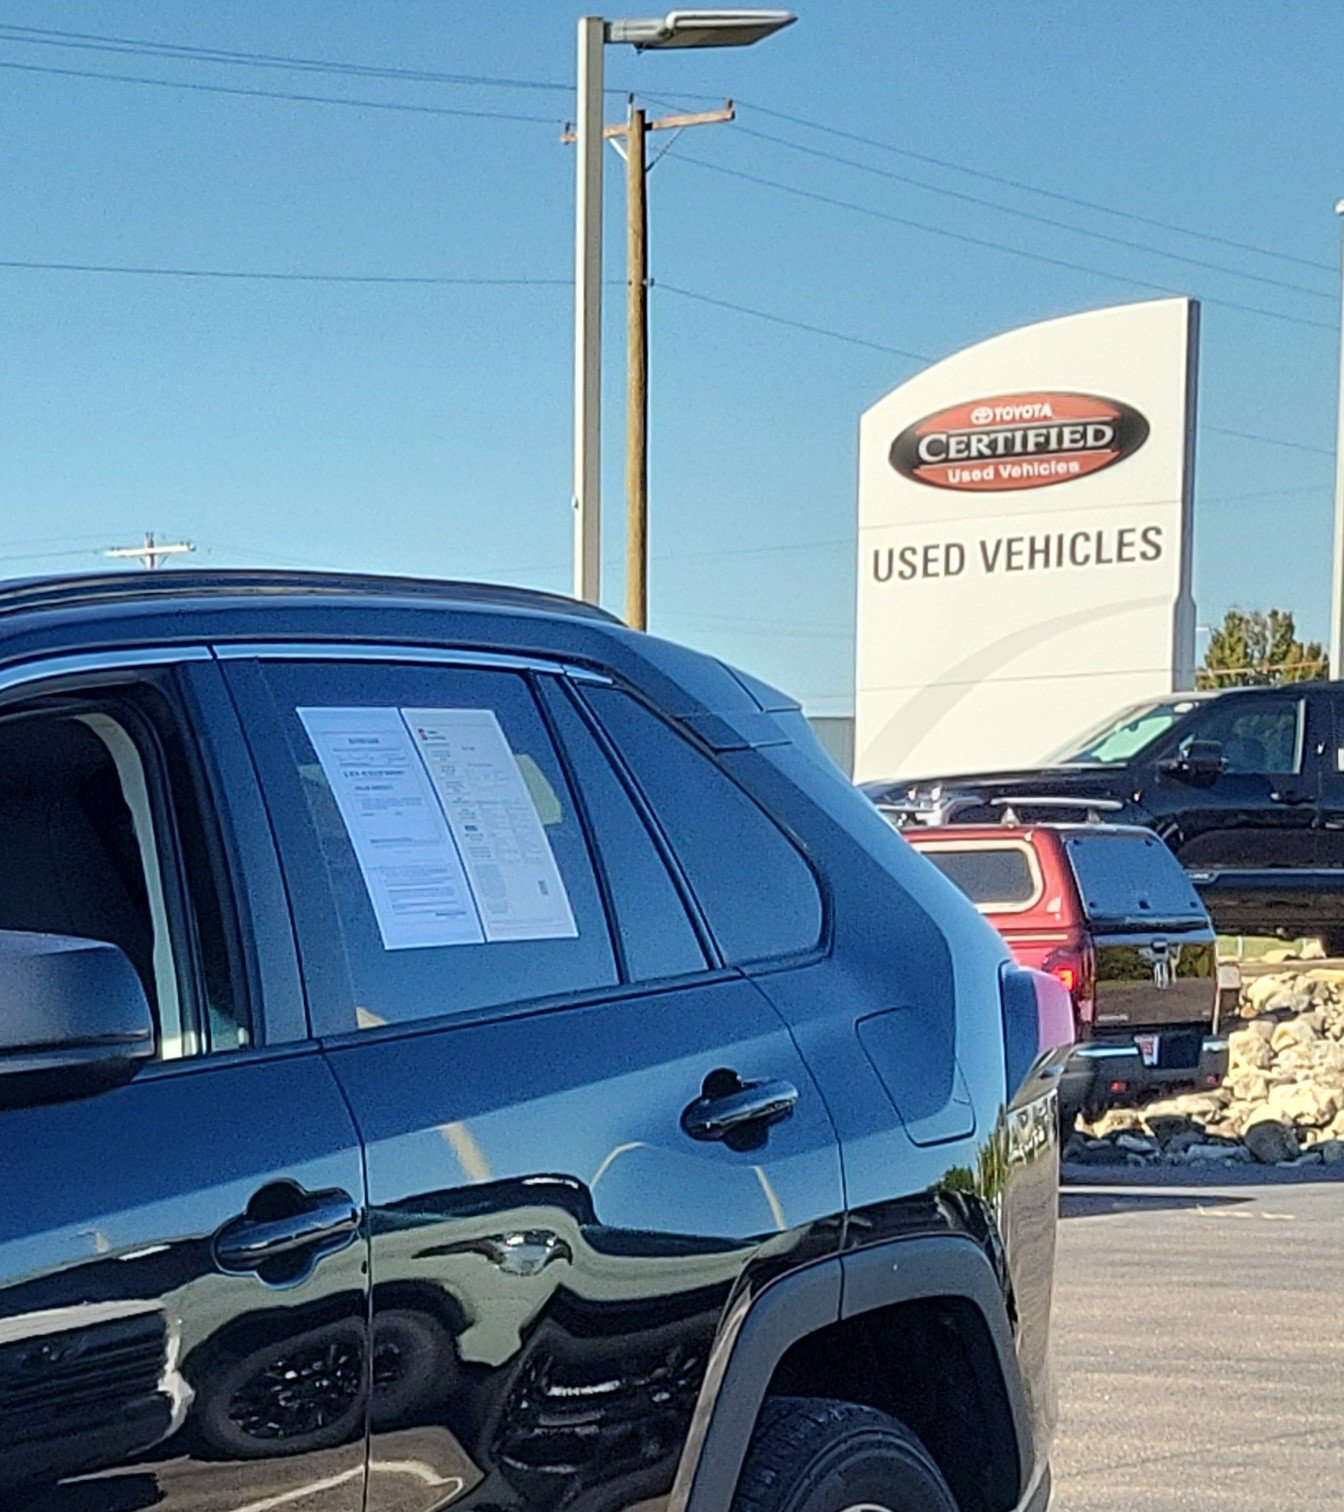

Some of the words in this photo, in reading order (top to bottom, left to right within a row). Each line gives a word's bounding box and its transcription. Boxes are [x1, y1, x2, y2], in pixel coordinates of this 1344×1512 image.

[994, 403, 1054, 422] TOYOTA
[917, 424, 1113, 463] CERTIFIED
[947, 467, 994, 484] Used
[999, 460, 1081, 478] Vehicles
[872, 543, 965, 582] USED
[979, 526, 1162, 573] VEHICLES
